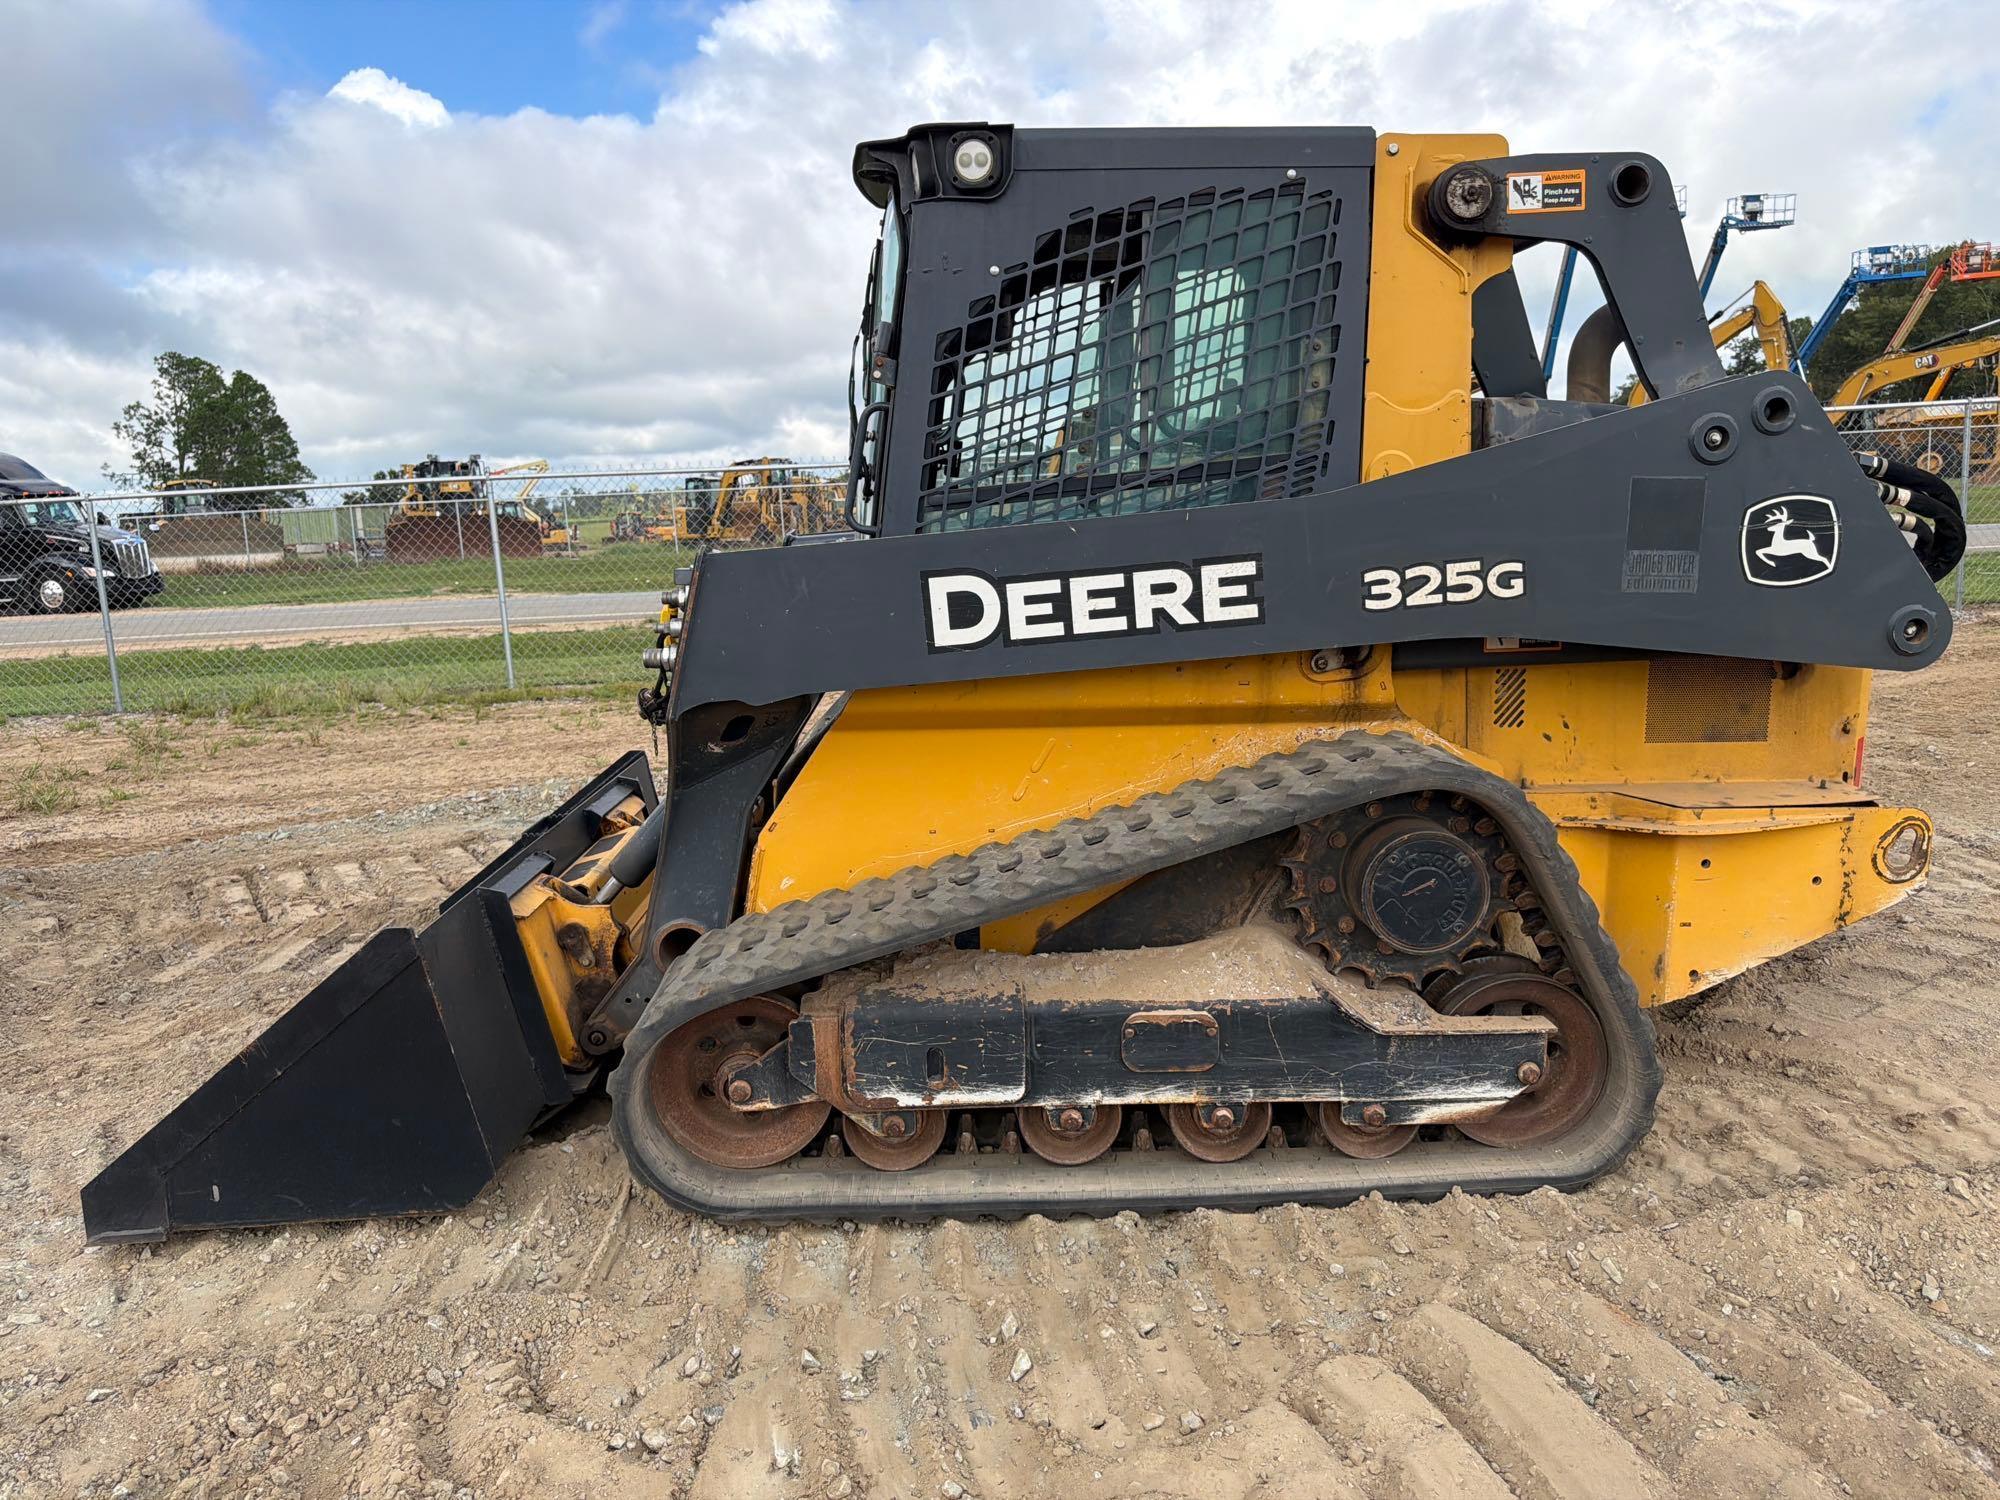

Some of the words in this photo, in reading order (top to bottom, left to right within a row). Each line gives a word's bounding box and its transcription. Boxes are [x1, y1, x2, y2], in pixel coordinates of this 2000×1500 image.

[1552, 173, 1581, 181] WARNING
[1915, 355, 1933, 368] CAT
[1666, 553, 1695, 574] RIVER
[1364, 560, 1524, 610] 325G
[928, 560, 1259, 647] DEERE
